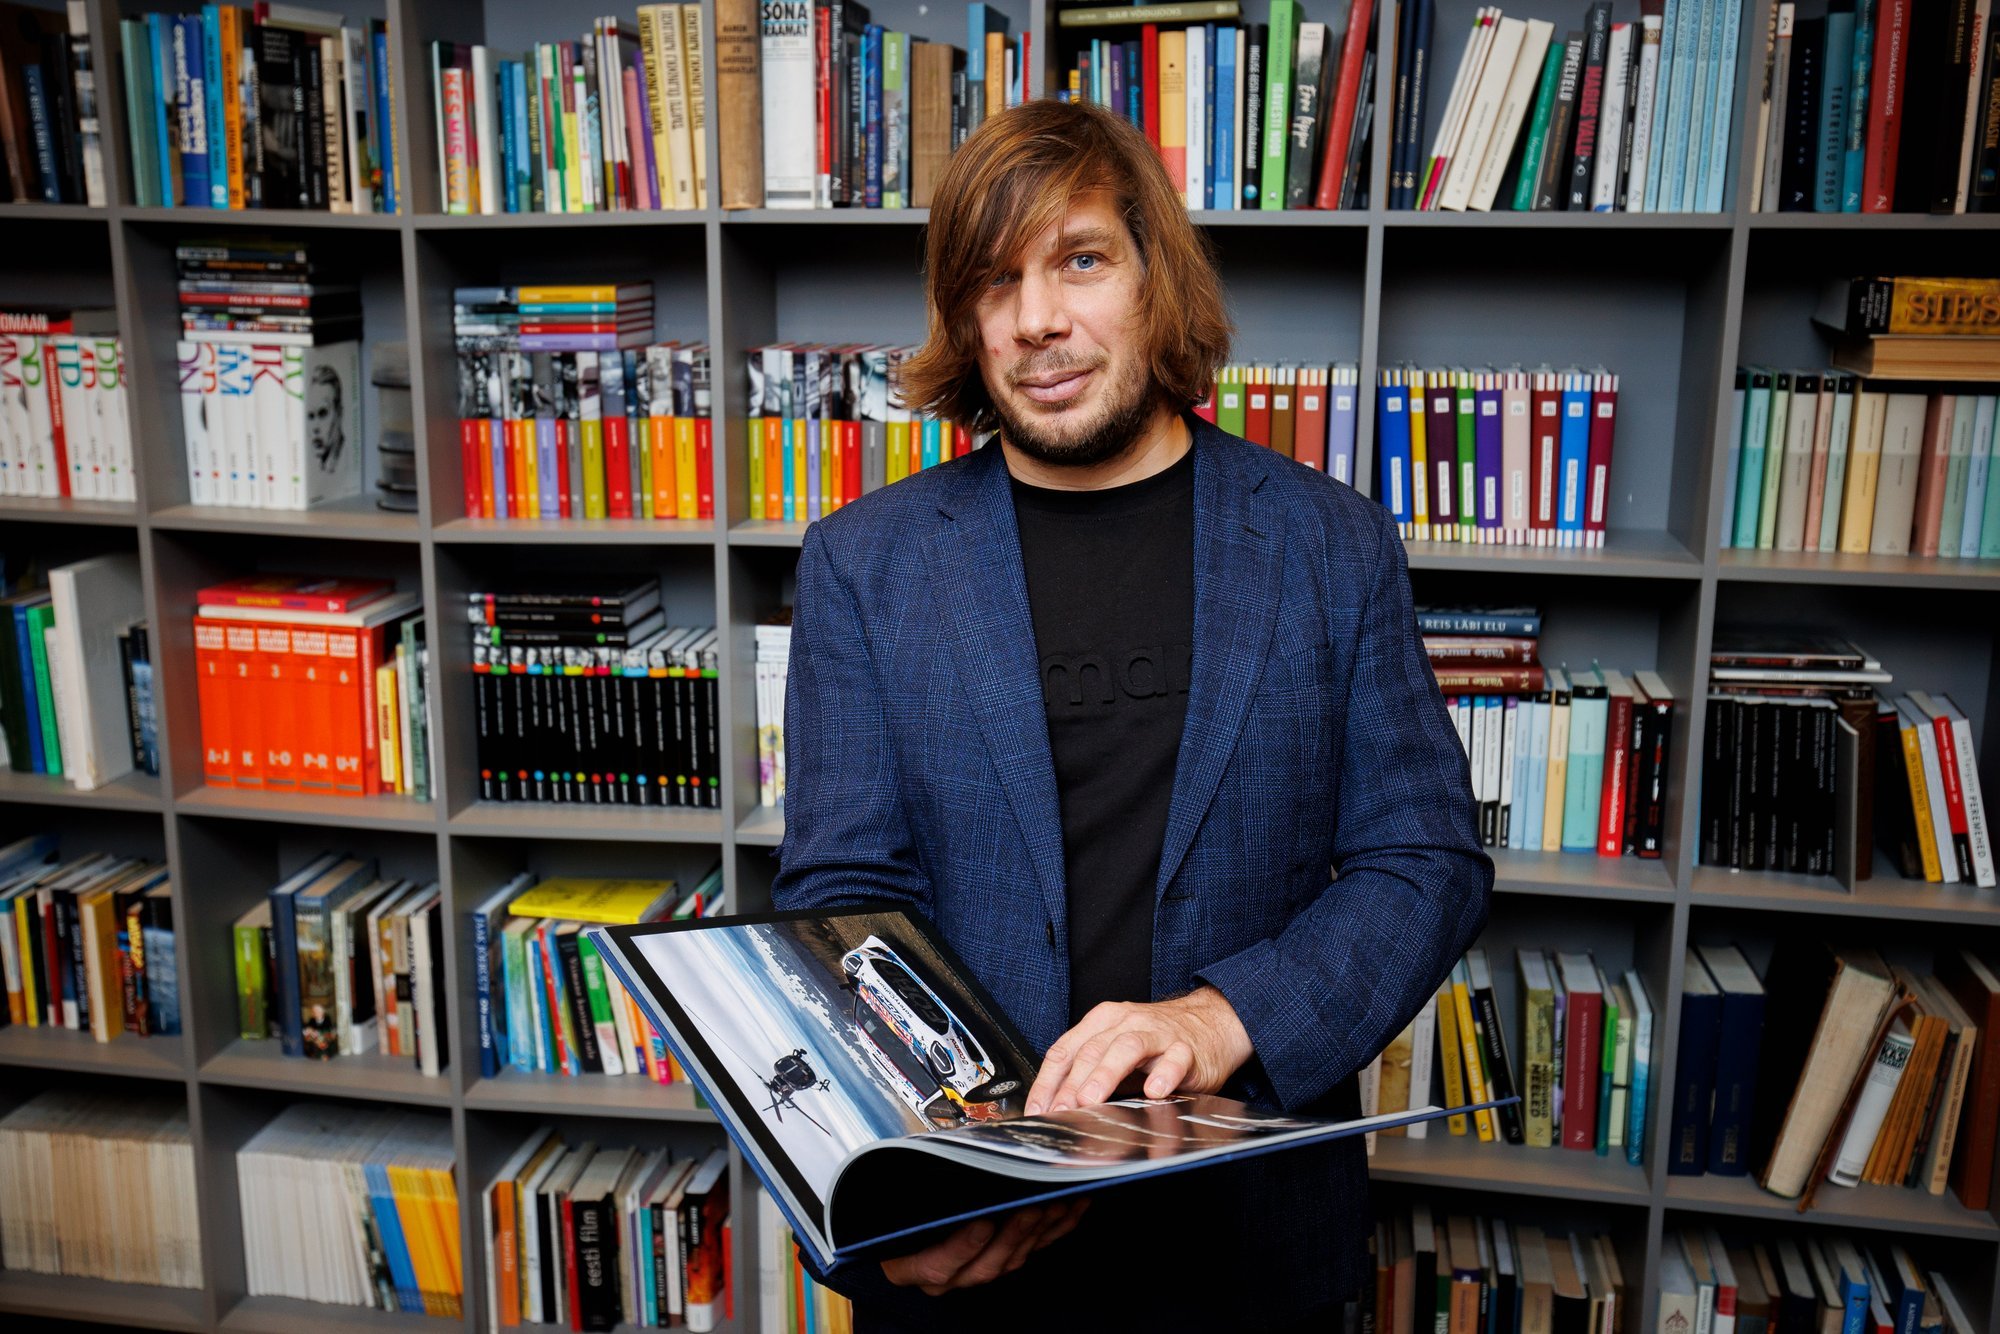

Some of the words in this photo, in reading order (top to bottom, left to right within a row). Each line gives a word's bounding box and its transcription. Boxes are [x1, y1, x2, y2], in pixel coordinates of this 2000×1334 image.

[1893, 1, 1903, 28] LASTE
[1558, 39, 1584, 102] TOPELTELU
[1579, 65, 1603, 117] MAGUS
[444, 72, 460, 114] KES
[1270, 82, 1285, 129] IGAVESTI
[447, 119, 463, 155] MIS
[1575, 119, 1595, 157] VALU
[1828, 85, 1843, 162] TEATRIELU
[448, 158, 466, 202] KUS
[1823, 170, 1837, 206] 2005
[1425, 620, 1451, 630] REIS
[1454, 619, 1481, 631] LÄBI
[1484, 621, 1506, 632] ELU
[1969, 795, 1987, 859] PEREMEHED
[876, 978, 914, 1019] SafetyCulture
[579, 1208, 598, 1245] film
[581, 1247, 602, 1287] eesti
